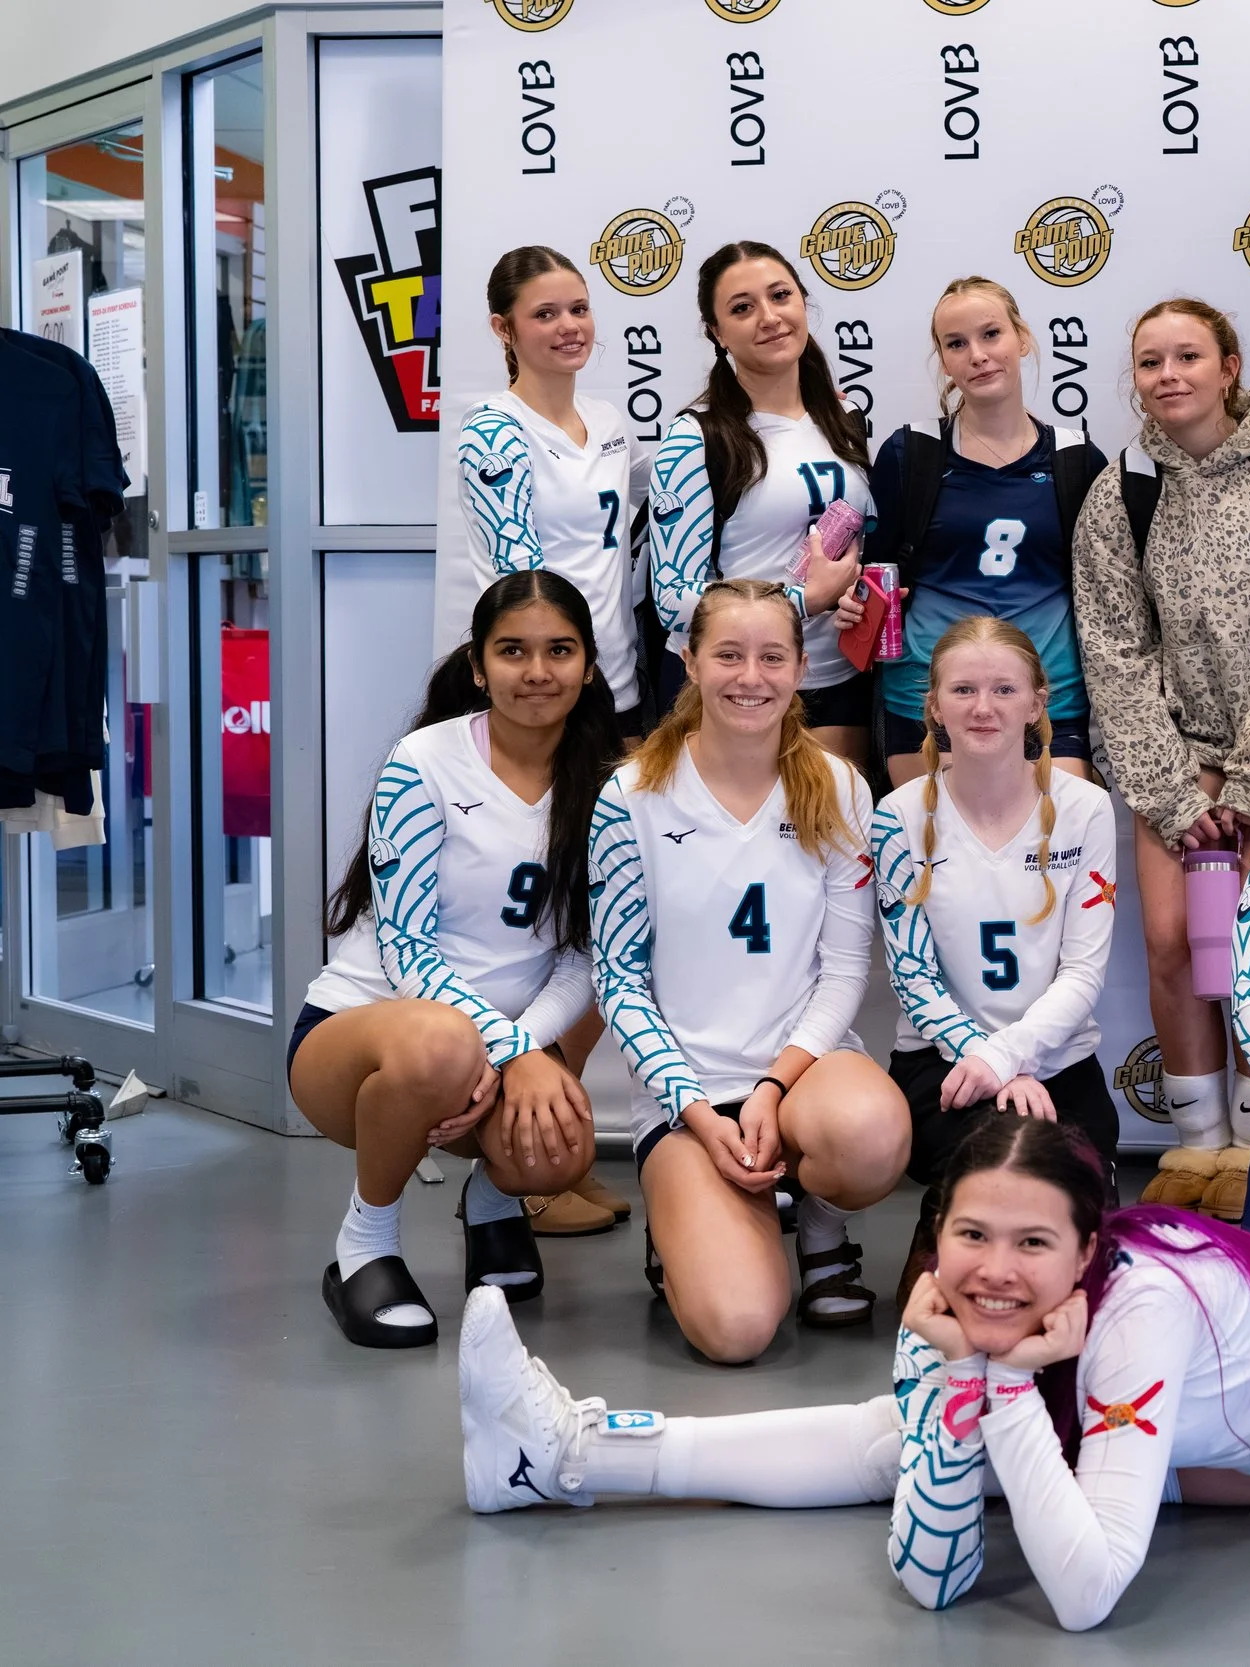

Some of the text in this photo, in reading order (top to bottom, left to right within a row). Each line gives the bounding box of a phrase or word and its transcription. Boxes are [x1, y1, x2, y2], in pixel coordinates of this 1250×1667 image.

[518, 60, 556, 174] LOVB
[726, 51, 765, 166] LOVB
[940, 44, 980, 160] LOVB
[1159, 36, 1199, 154] LOVB
[590, 230, 654, 265] GAME
[628, 239, 686, 282] POINT
[800, 223, 866, 258] GAME
[839, 232, 897, 276] POINT
[1014, 218, 1081, 254] GAME
[1054, 228, 1114, 272] POINT
[624, 325, 662, 442] LOVB
[835, 320, 874, 438] OVB
[1048, 316, 1088, 432] OVB
[796, 461, 845, 516] 17
[598, 490, 620, 549] 7
[978, 518, 1027, 577] 8
[879, 638, 888, 656] Red
[1061, 846, 1082, 860] WAVE
[500, 861, 547, 929] 9
[728, 882, 771, 954] 4
[980, 921, 1020, 992] 5
[1113, 1062, 1164, 1090] GAM
